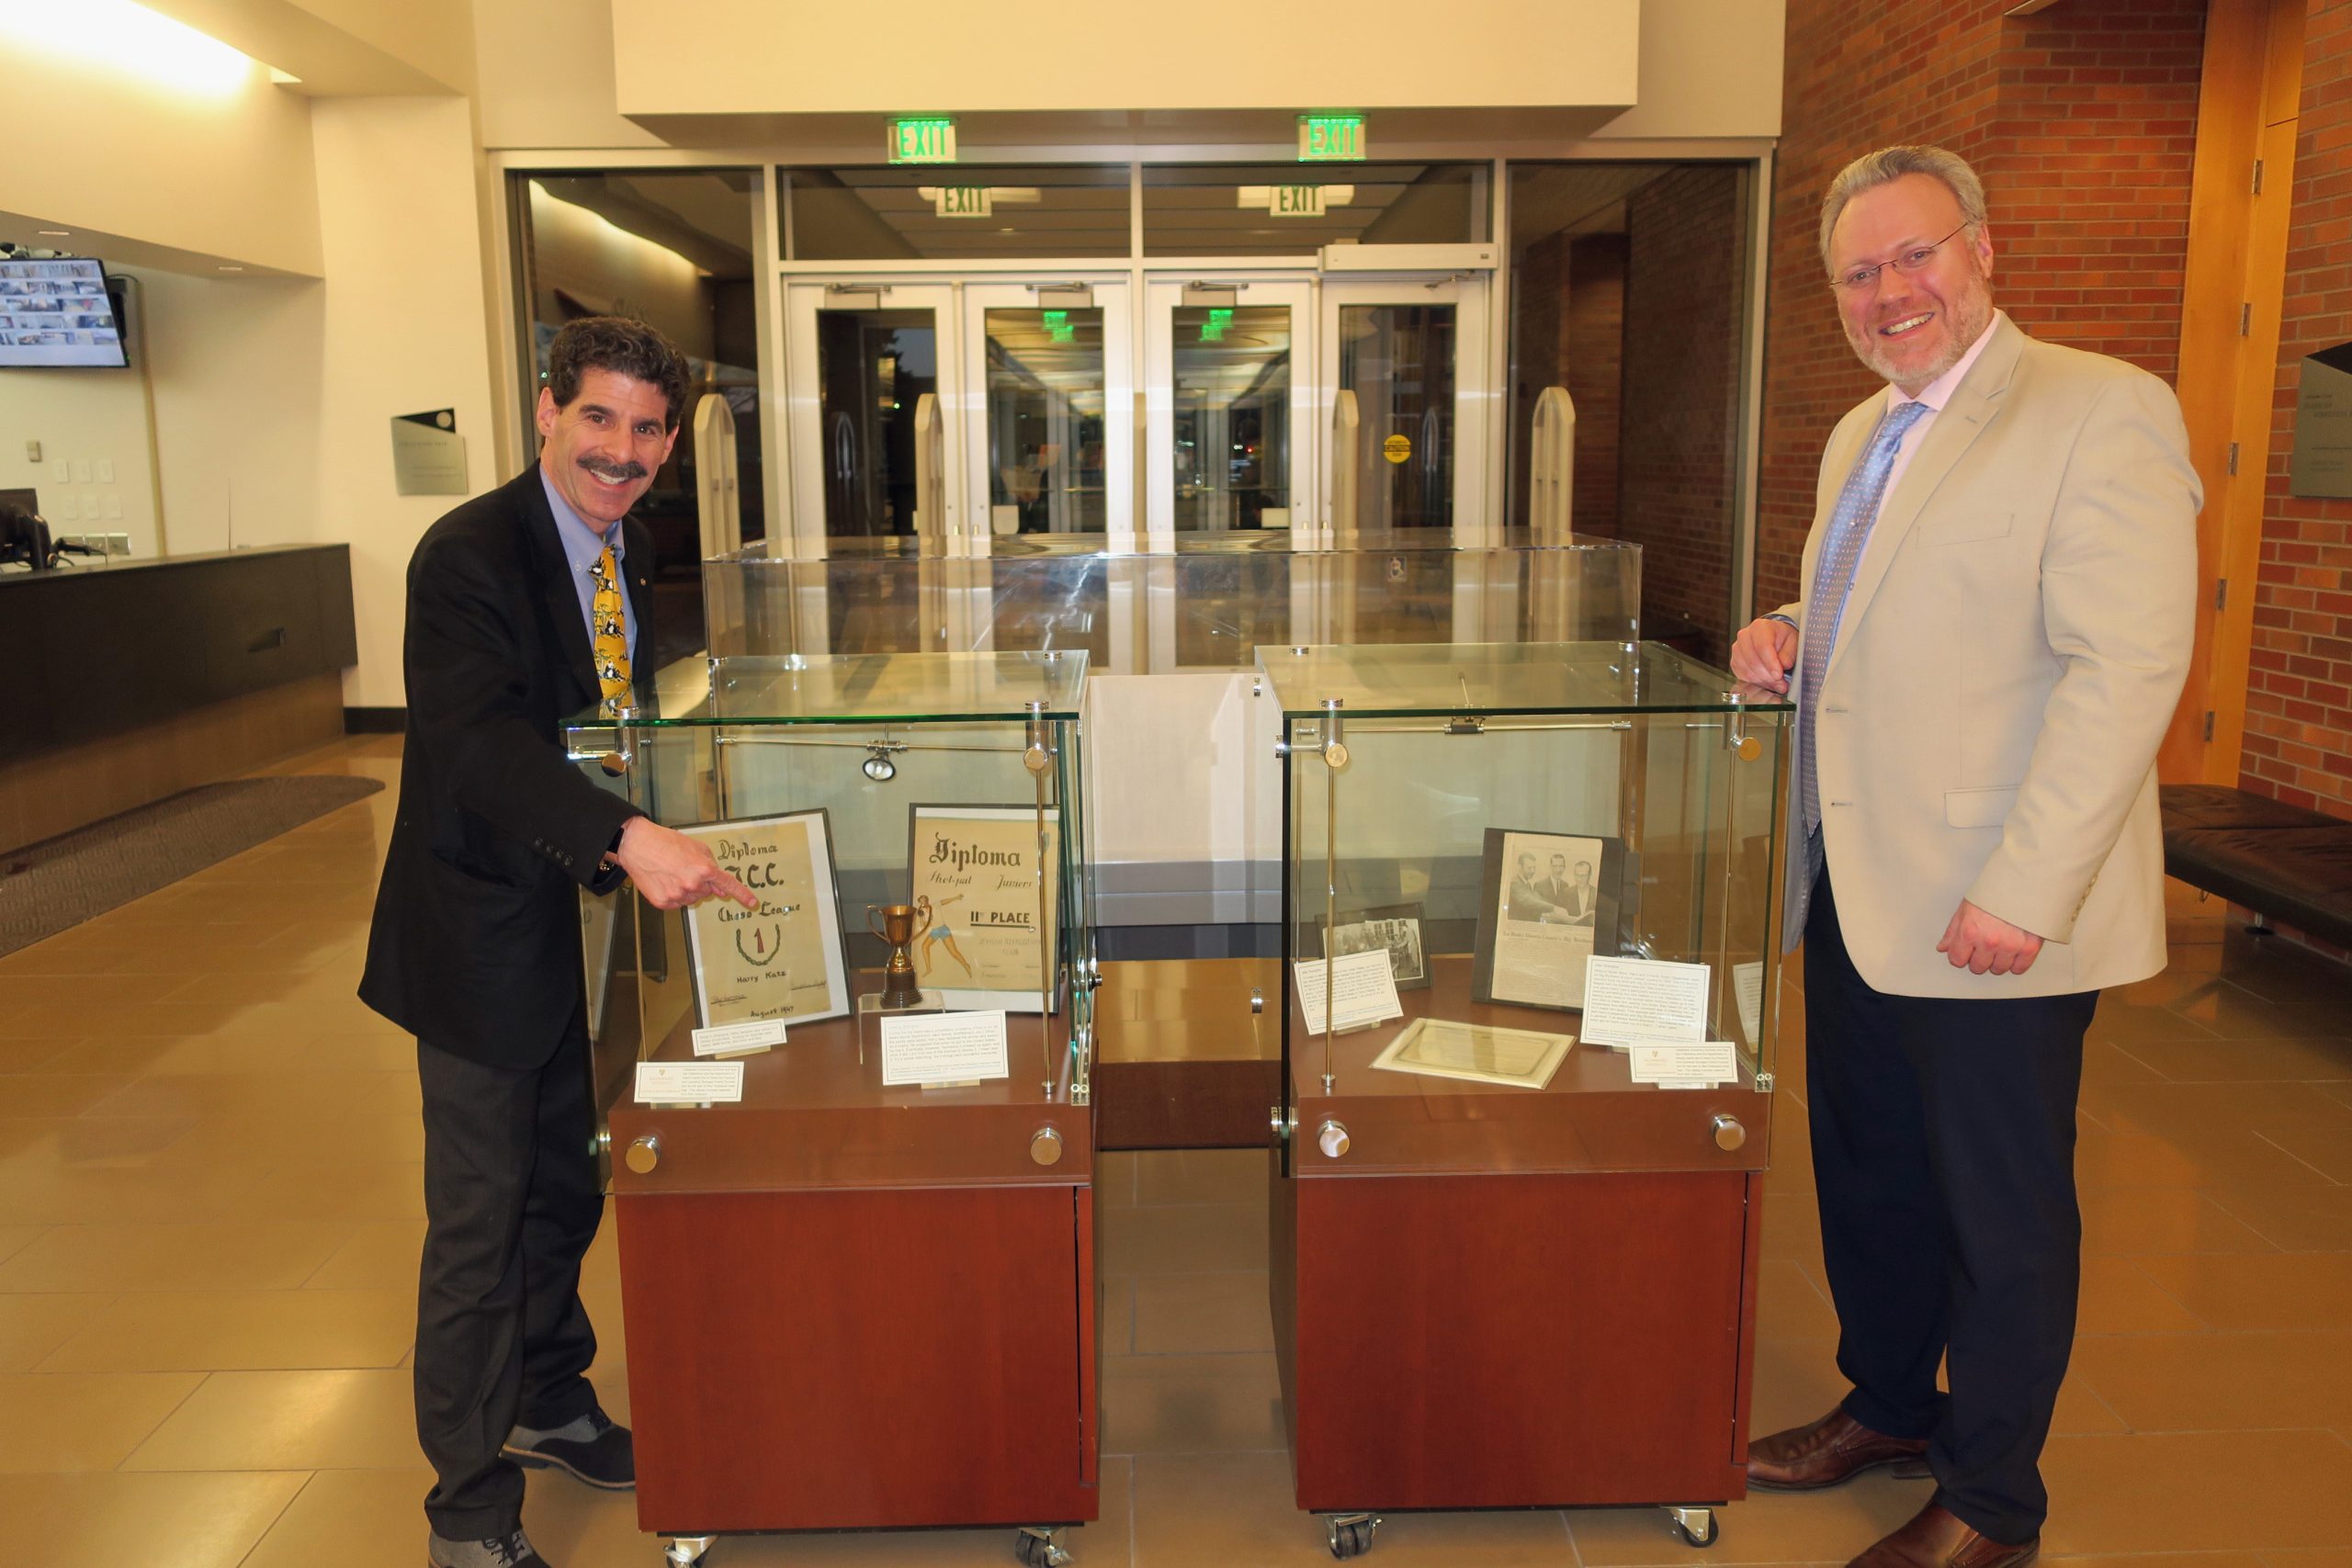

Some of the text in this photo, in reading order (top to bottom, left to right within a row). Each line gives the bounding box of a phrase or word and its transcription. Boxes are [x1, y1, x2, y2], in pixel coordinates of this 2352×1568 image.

[899, 121, 950, 157] EXIT
[1309, 119, 1360, 154] EXIT
[945, 186, 983, 212] EXIT
[1280, 186, 1319, 211] EXIT
[718, 839, 778, 860] Diploma
[929, 831, 1021, 872] Diploma
[724, 862, 785, 888] JC.C.
[759, 901, 801, 917] League
[990, 911, 1030, 923] PLACE
[753, 928, 764, 953] 1
[737, 975, 759, 984] Harry
[751, 1008, 777, 1018] August
